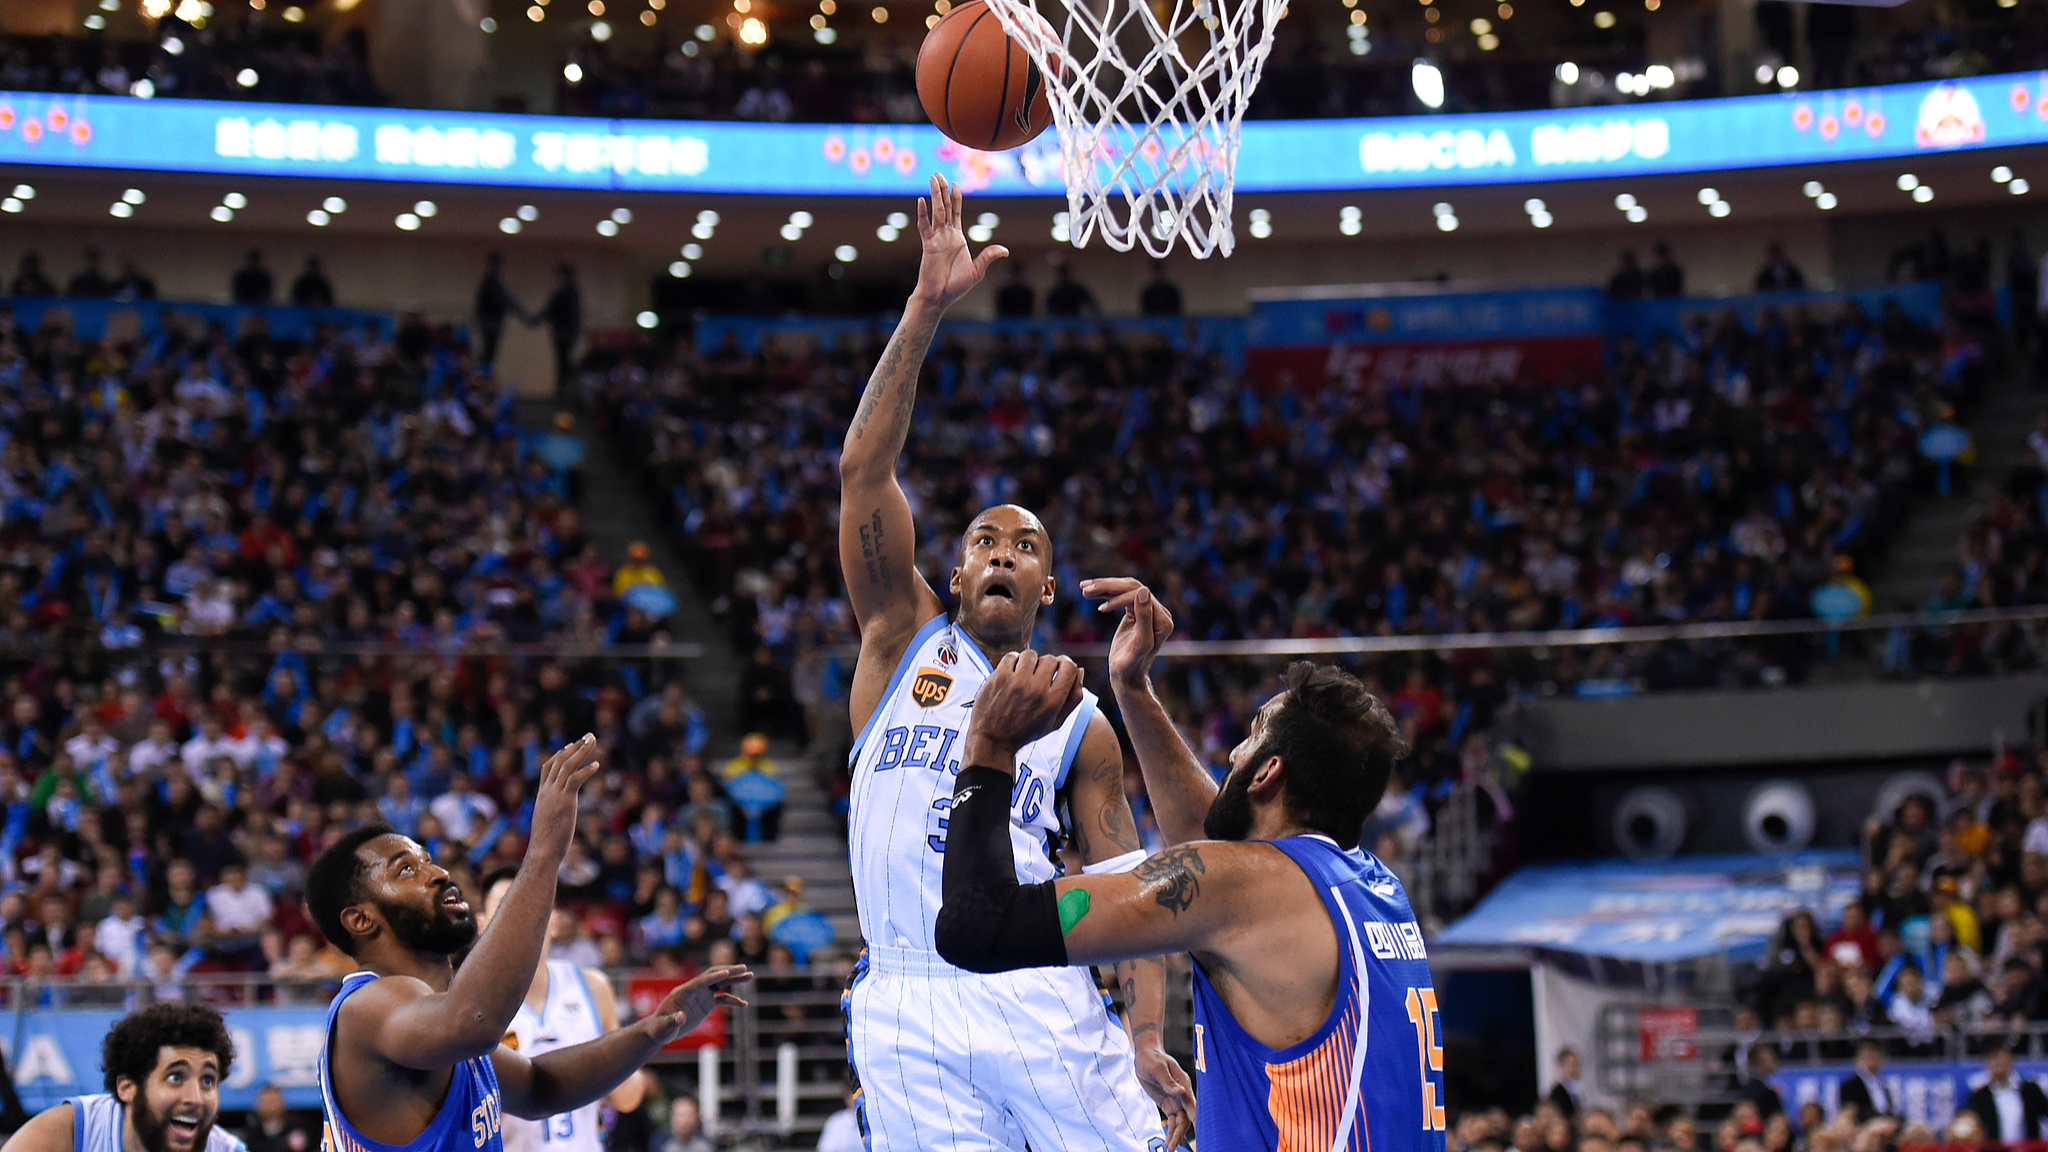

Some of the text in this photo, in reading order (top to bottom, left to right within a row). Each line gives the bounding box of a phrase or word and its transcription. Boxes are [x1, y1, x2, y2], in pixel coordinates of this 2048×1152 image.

[914, 677, 947, 703] ups
[1405, 987, 1446, 1130] 15
[541, 1110, 573, 1143] 13
